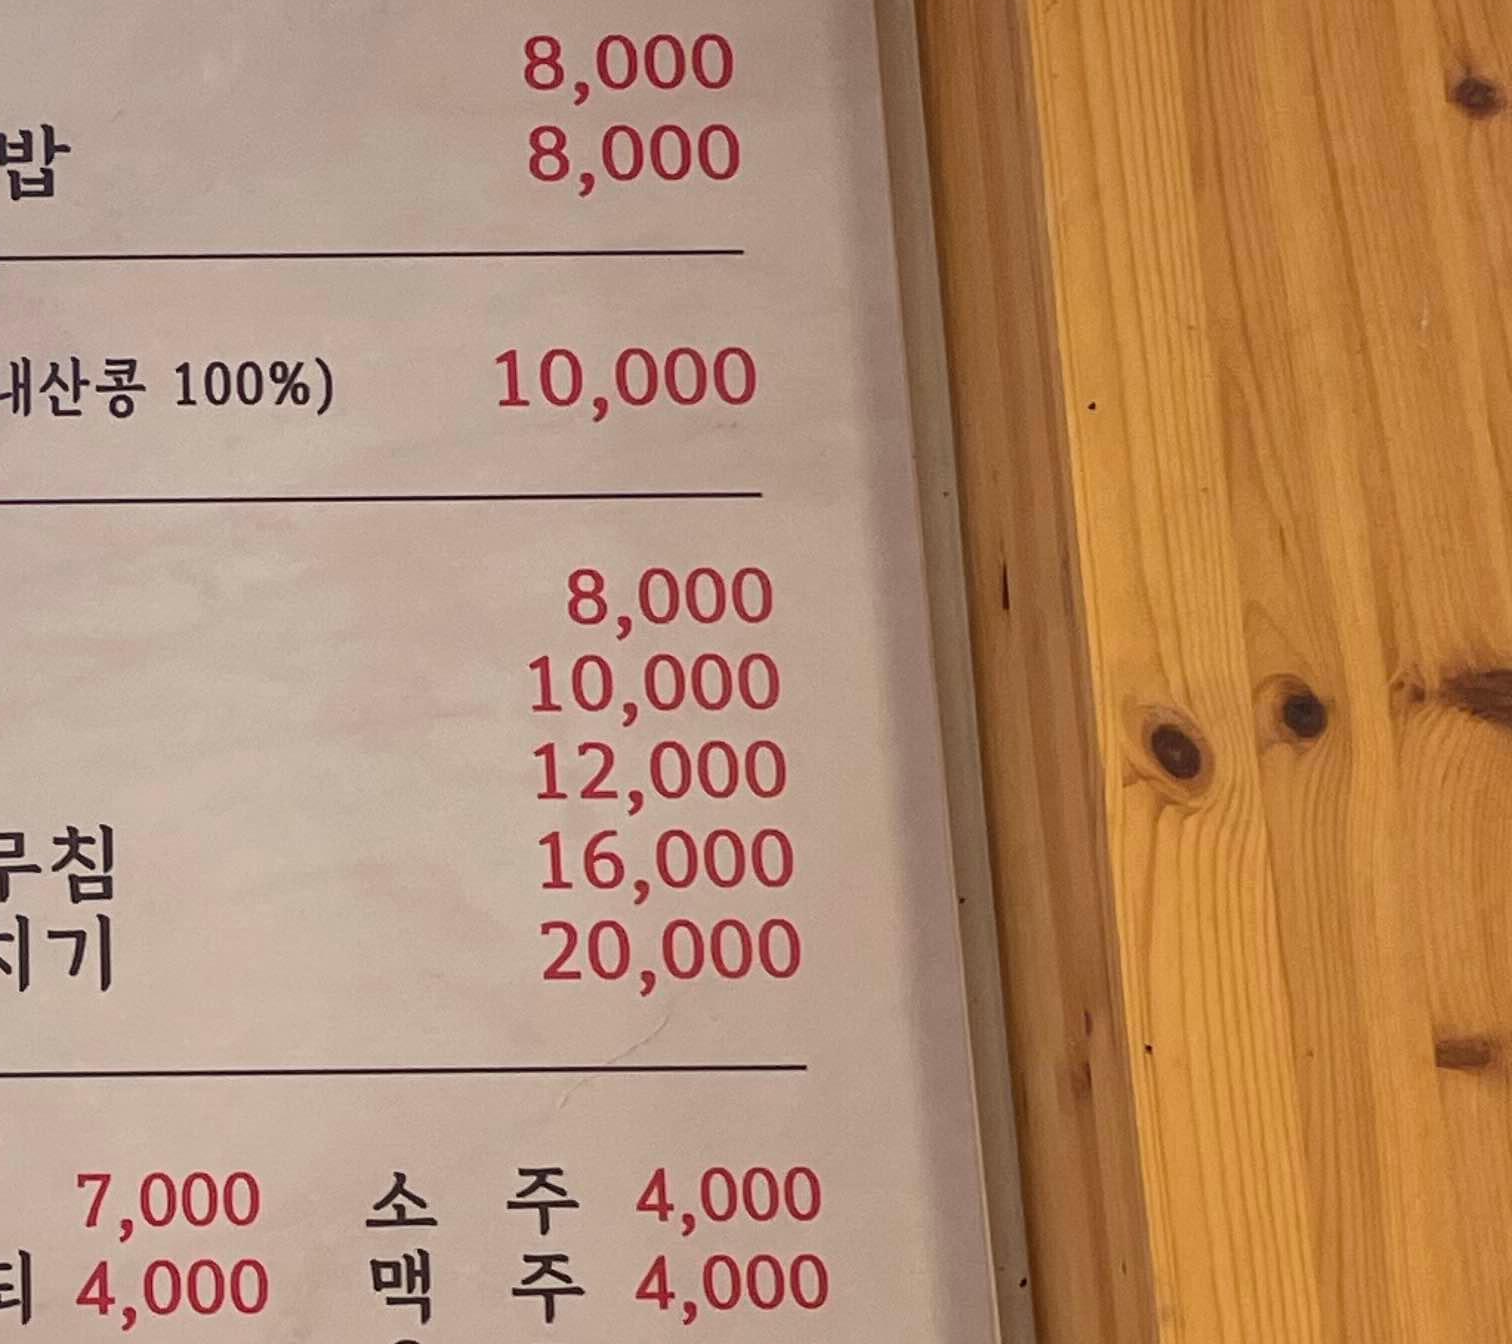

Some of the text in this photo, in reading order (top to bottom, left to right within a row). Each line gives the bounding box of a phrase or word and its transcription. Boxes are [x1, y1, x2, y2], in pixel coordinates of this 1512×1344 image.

[525, 34, 733, 105] 8,000
[530, 124, 739, 197] 8,000
[176, 358, 332, 415] 100%)
[496, 347, 756, 422] 10,000
[568, 568, 772, 640] 8,000
[529, 653, 779, 727] 10,000
[534, 741, 786, 816] 12,000
[539, 829, 793, 904] 16,000
[542, 919, 800, 997] 20,000
[78, 1172, 259, 1242] 7,000
[636, 1167, 820, 1236] 4,000
[76, 1259, 268, 1331] 4,000
[636, 1254, 828, 1325] 4,000
